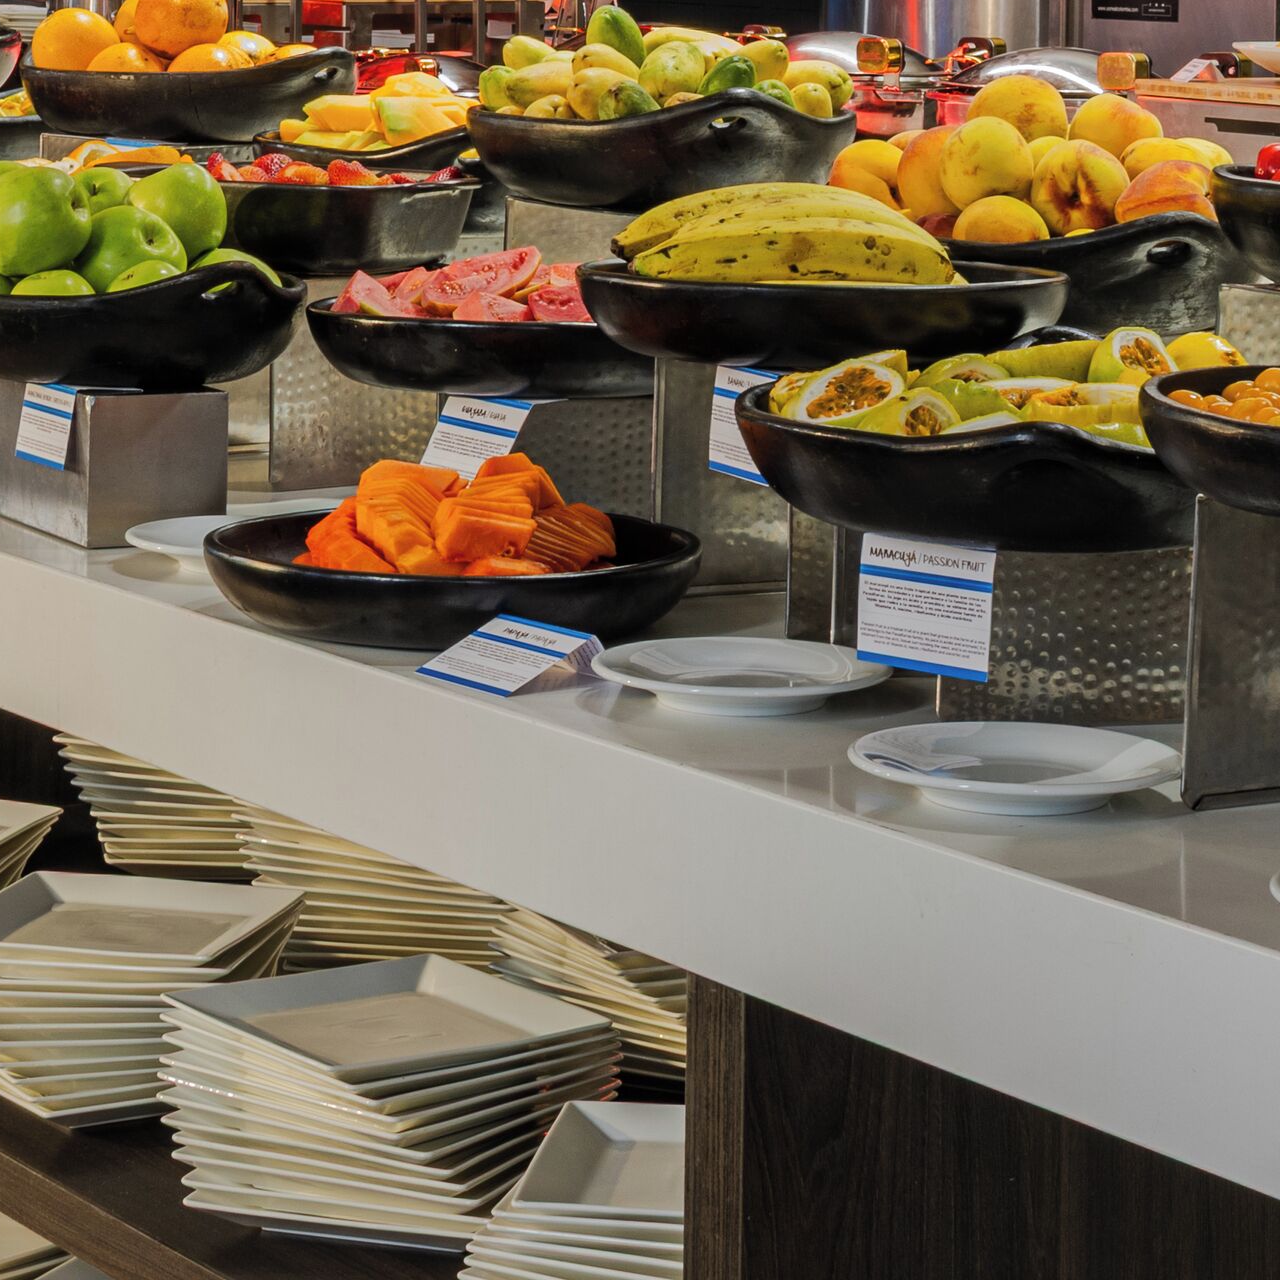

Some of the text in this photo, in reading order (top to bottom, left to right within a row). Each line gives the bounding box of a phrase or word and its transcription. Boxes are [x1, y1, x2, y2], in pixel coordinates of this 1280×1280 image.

[869, 545, 917, 567] MARACUYÁ
[923, 553, 960, 569] PASSION
[961, 559, 988, 573] FRUIT
